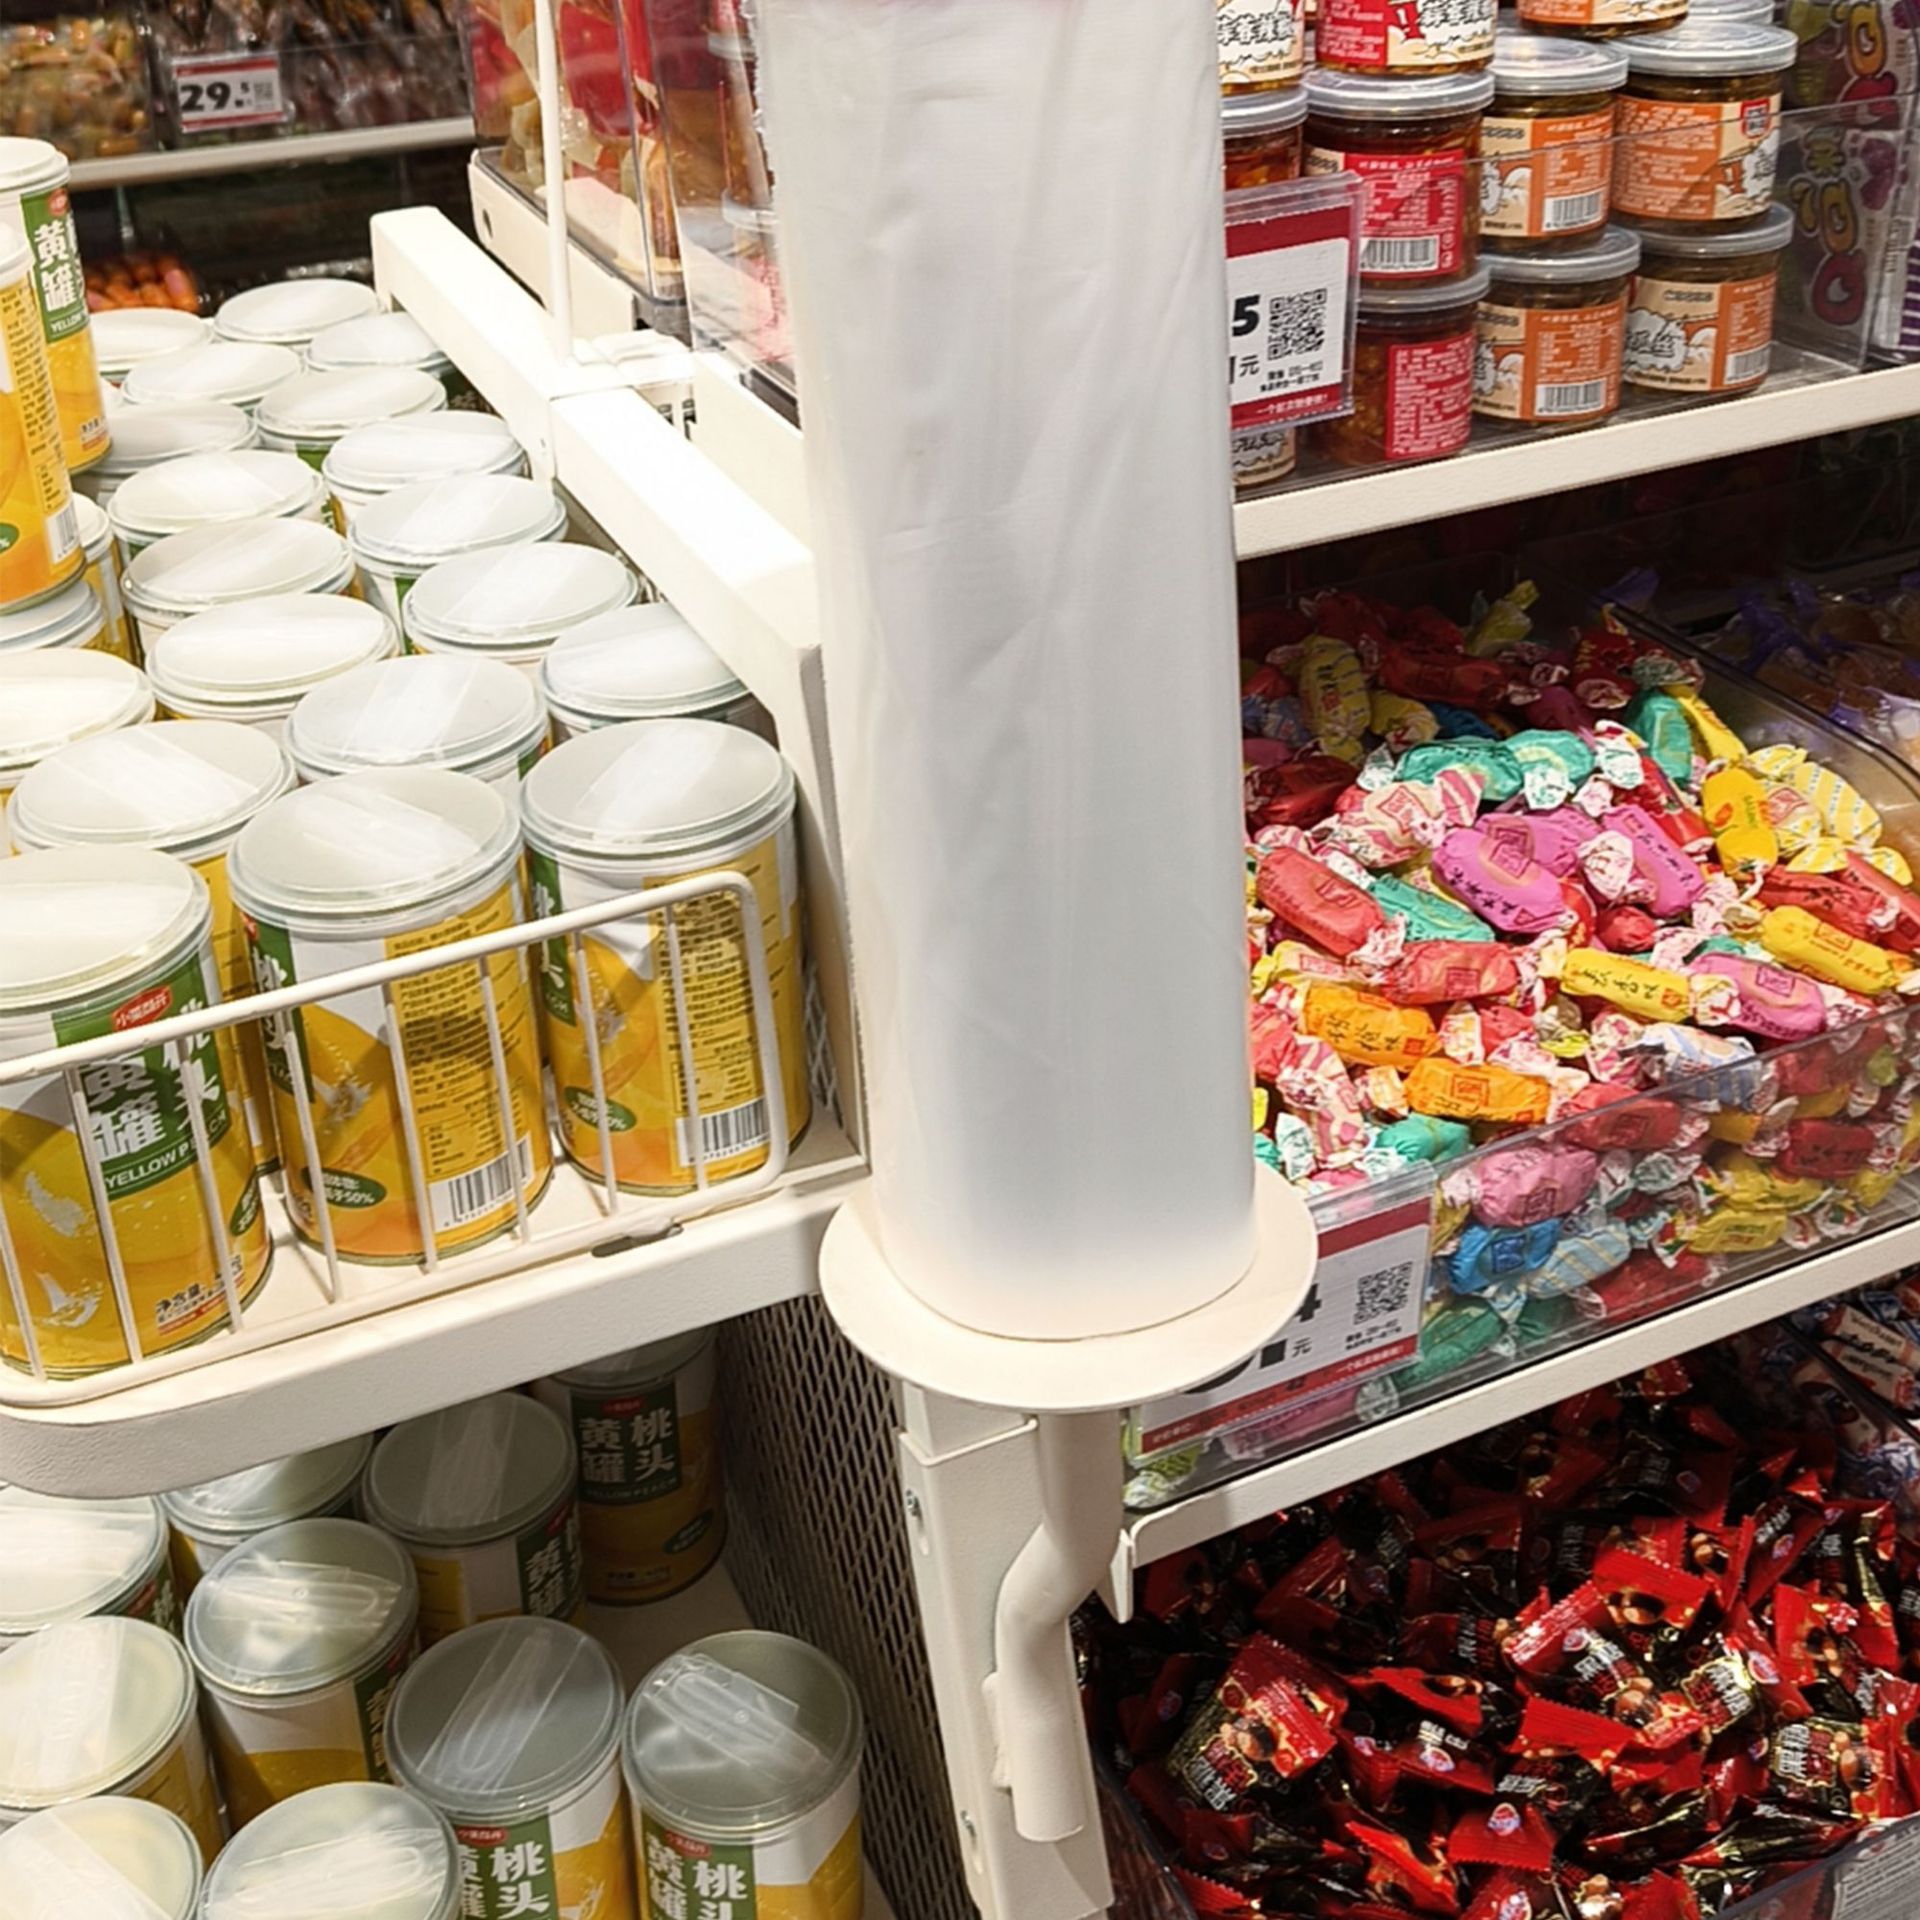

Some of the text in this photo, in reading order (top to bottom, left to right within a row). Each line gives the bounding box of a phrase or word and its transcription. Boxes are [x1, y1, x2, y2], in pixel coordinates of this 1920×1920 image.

[104, 1147, 177, 1189] YELLOW
[579, 1407, 675, 1450] 黄桃
[581, 1443, 676, 1483] 罐头
[1779, 1723, 1809, 1779] 黑糖
